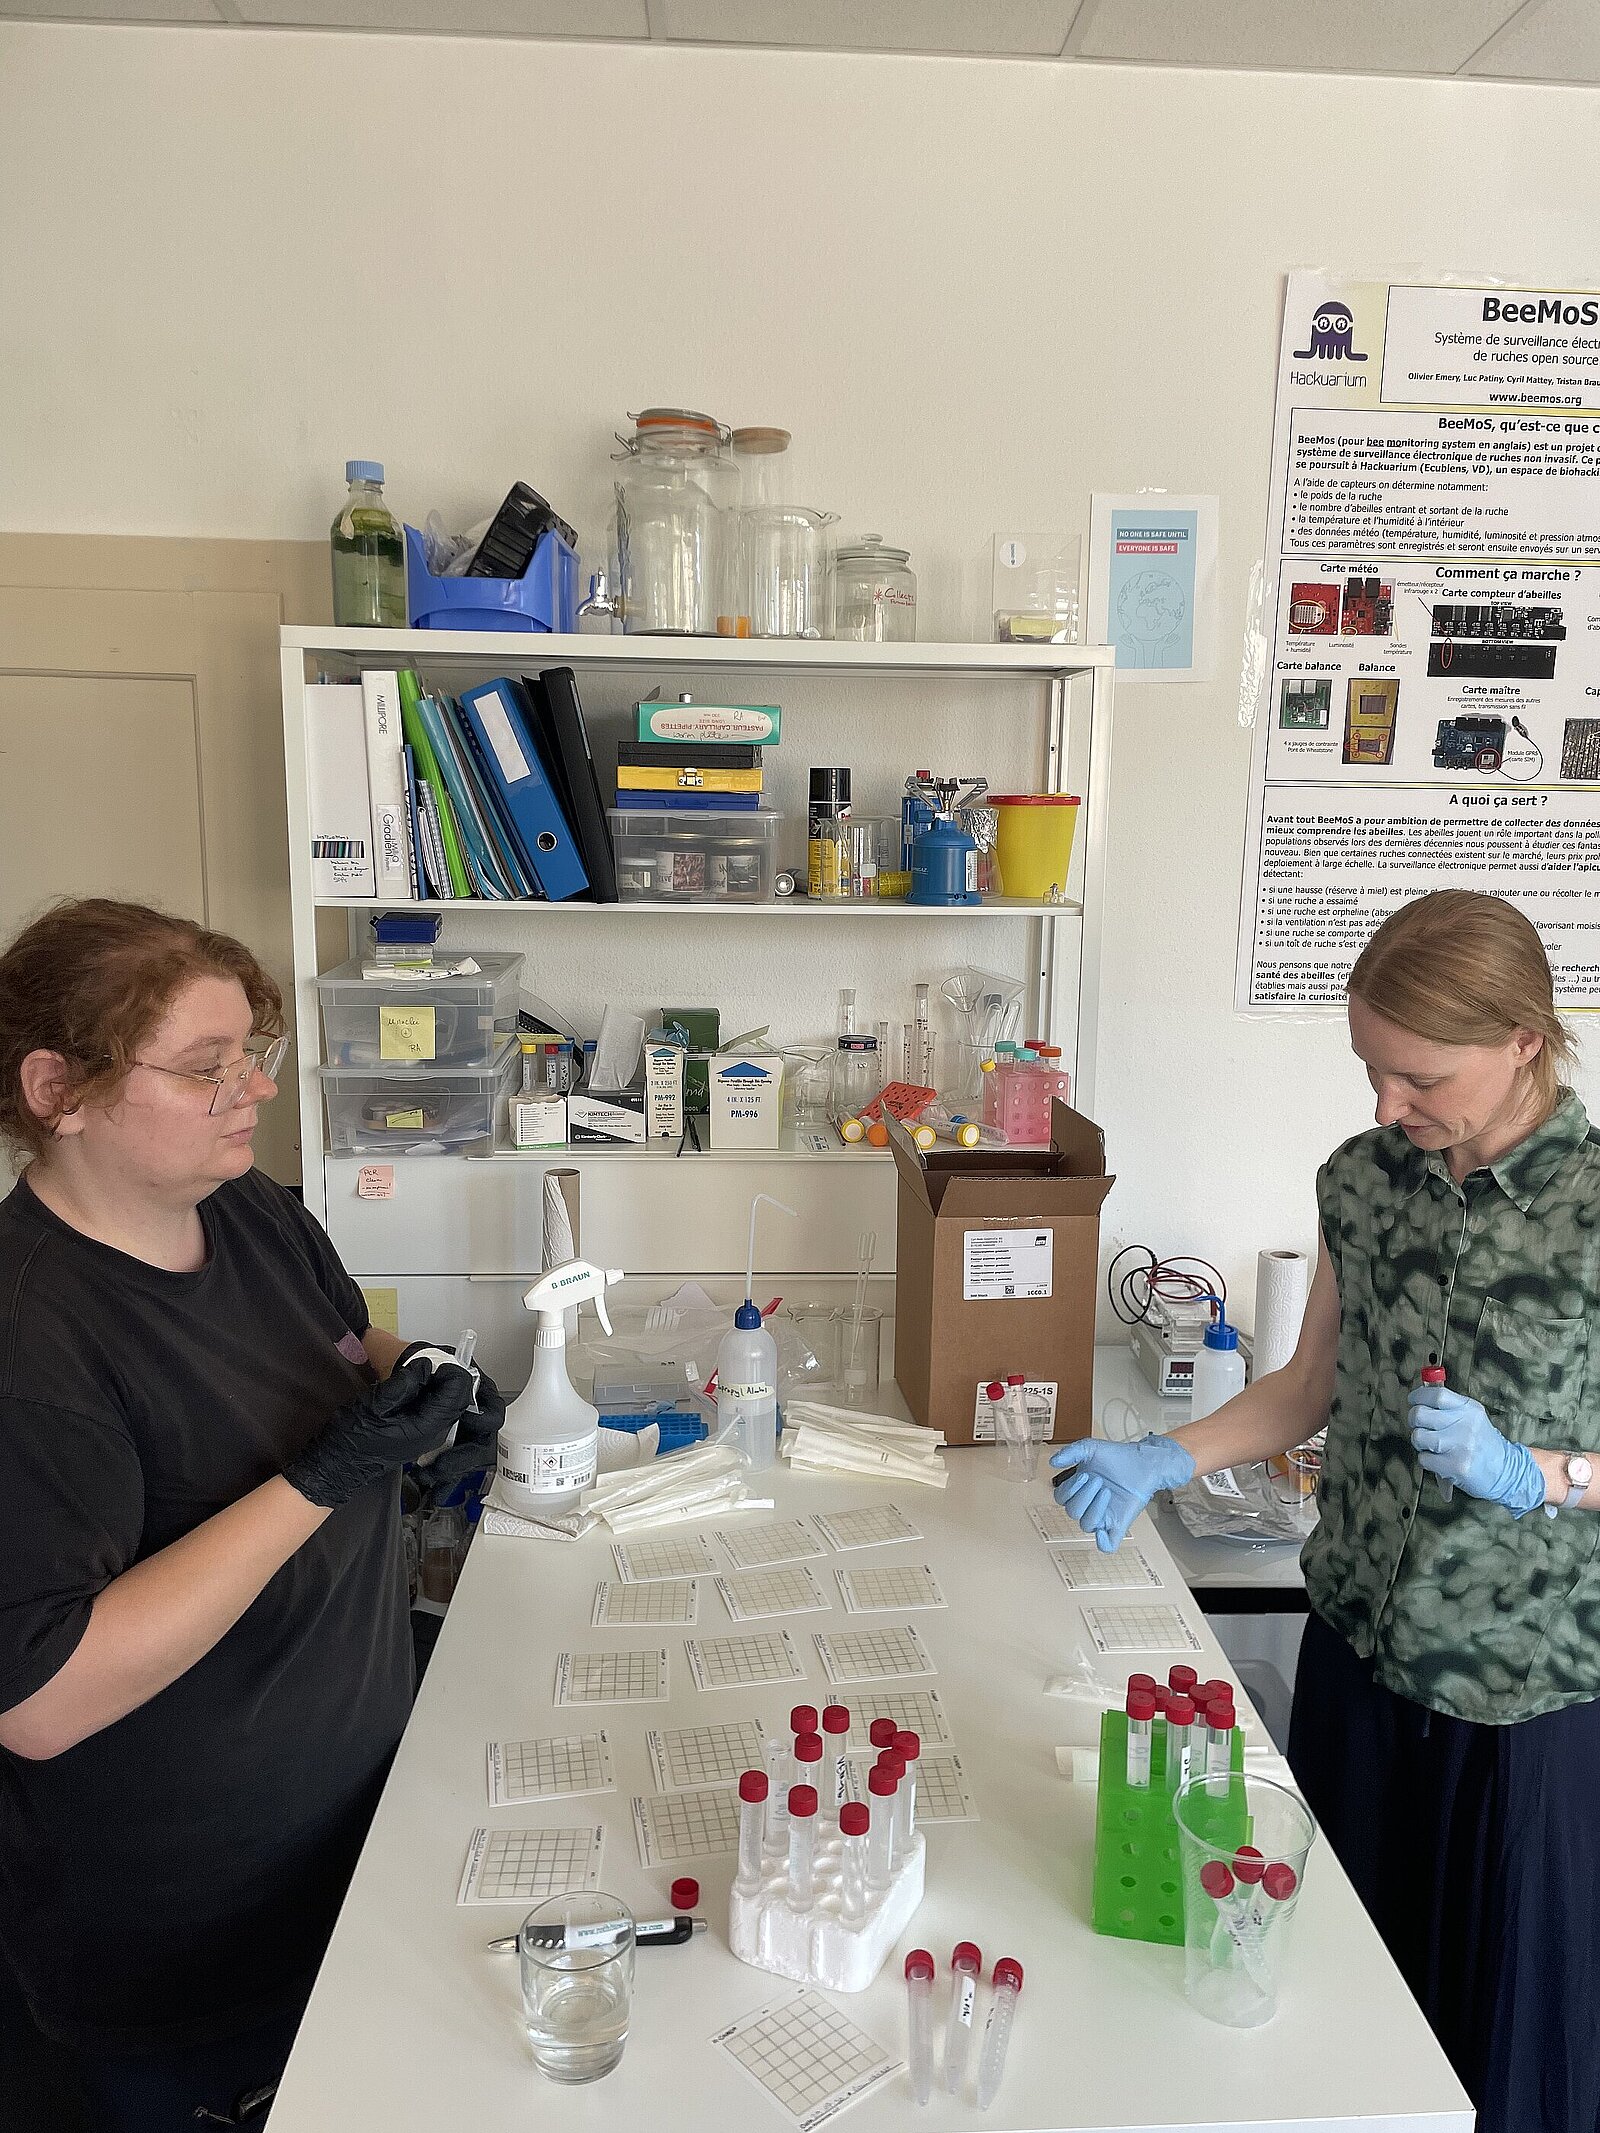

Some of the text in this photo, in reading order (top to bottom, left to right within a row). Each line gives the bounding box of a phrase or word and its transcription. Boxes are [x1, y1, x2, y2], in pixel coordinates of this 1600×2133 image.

[1482, 297, 1598, 325] BeeMoS
[1434, 331, 1482, 346] Système
[1485, 333, 1500, 345] de
[1503, 334, 1568, 347] surveillance
[1473, 349, 1598, 365] de ruches open source
[1290, 369, 1366, 387] Hackuarium
[1408, 372, 1433, 380] Olivier
[1435, 373, 1461, 382] Emery,
[1478, 374, 1504, 384] Patiny,
[1506, 375, 1524, 384] Cyril
[1526, 376, 1554, 385] Mattey,
[1556, 377, 1581, 385] Tristan
[1489, 392, 1581, 406] www.beemos.org
[1438, 417, 1588, 435] BeeMoS, qu'est-ce que
[1297, 435, 1335, 444] BeeMos
[1337, 435, 1364, 447] (pour
[1366, 436, 1384, 447] bee
[1386, 437, 1439, 449] monitoring
[1441, 439, 1475, 450] system
[1478, 441, 1490, 449] en
[1492, 440, 1530, 452] anglais)
[1533, 442, 1548, 450] est
[1565, 442, 1595, 453] projet
[1296, 446, 1336, 458] système
[1338, 448, 1351, 457] de
[1353, 448, 1410, 459] surveillance
[1412, 449, 1472, 462] électronique
[1475, 451, 1487, 461] de
[1489, 452, 1521, 462] ruches
[1544, 453, 1578, 463] invasif.
[1581, 455, 1593, 464] Ce
[1293, 477, 1300, 486] A
[1302, 477, 1324, 487] l'aide
[1327, 478, 1338, 487] de
[1340, 479, 1376, 490] capteurs
[1391, 479, 1434, 490] détermine
[1437, 482, 1488, 491] notamment:
[1300, 490, 1382, 501] le poids de la ruche
[1320, 563, 1378, 573] Carte météo
[1435, 566, 1581, 581] Comment ça marche ?
[1441, 588, 1561, 599] Carte compteur d'abeilles
[1276, 661, 1341, 670] Carte balance
[1358, 662, 1395, 671] Balance
[1462, 685, 1520, 694] Carte maître
[376, 694, 388, 734] MILLIPORE
[660, 722, 764, 732] PASTEUR CAPILLARY PIPETTES
[1449, 794, 1547, 807] A quoi ça sert ?
[1266, 815, 1293, 823] Avant
[1295, 815, 1315, 823] tout
[1317, 815, 1353, 824] BeeMoS
[1364, 818, 1385, 826] pour
[1387, 816, 1427, 825] ambition
[1429, 817, 1441, 825] de
[1443, 818, 1488, 827] permettre
[1490, 818, 1502, 826] de
[1504, 818, 1543, 826] collecter
[1545, 819, 1560, 827] des
[383, 813, 394, 859] Gradient
[1254, 991, 1347, 1000] satisfaire la curiosité
[731, 1110, 758, 1118] PM-996
[560, 1271, 591, 1287] BRAUN
